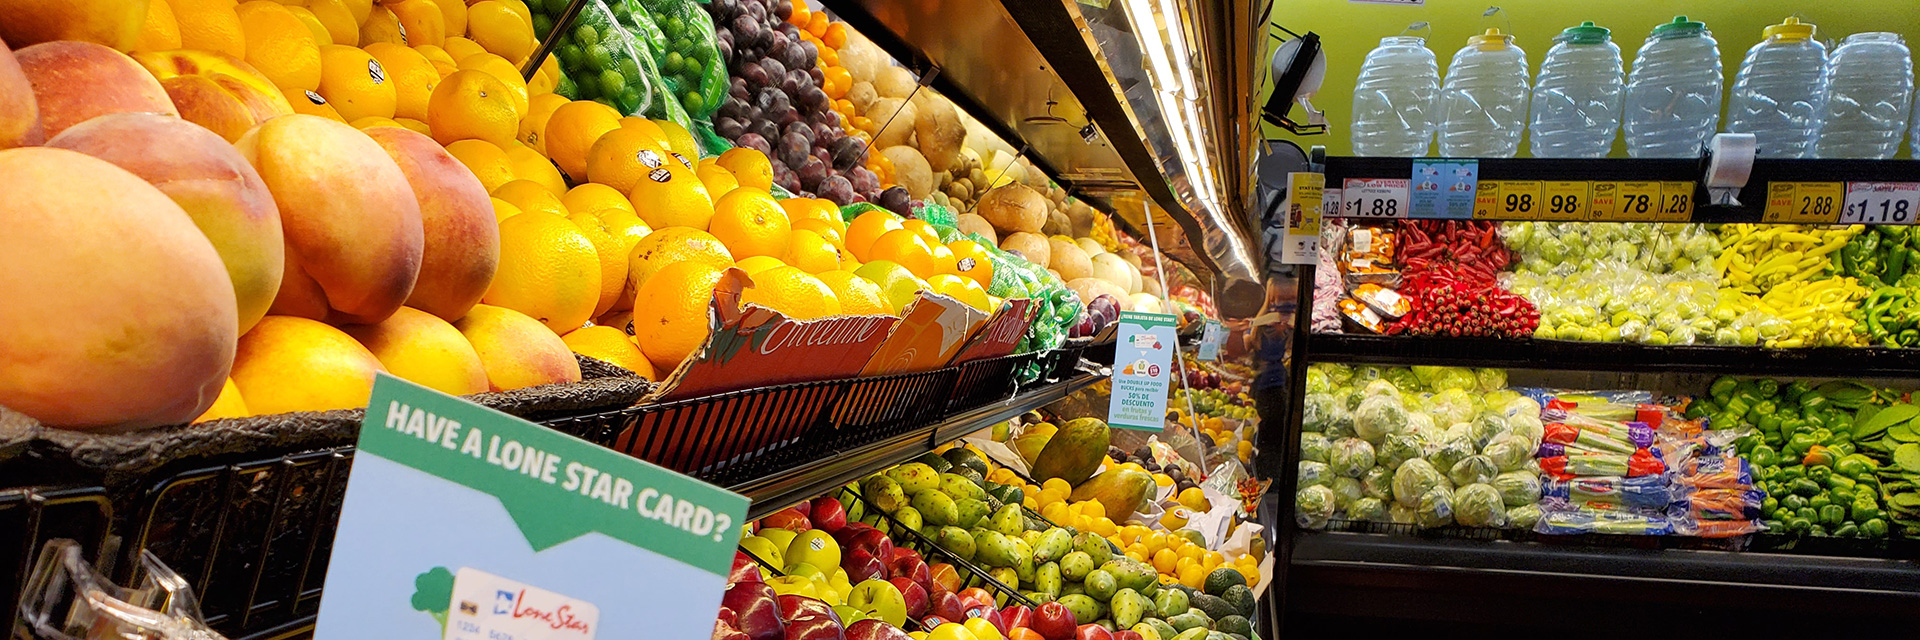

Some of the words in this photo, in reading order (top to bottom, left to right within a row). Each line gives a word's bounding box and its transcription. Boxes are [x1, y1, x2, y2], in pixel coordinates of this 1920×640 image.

[1345, 198, 1397, 217] $1.88
[1660, 194, 1688, 213] 1.28
[1847, 199, 1909, 222] $1.18
[1121, 399, 1154, 408] DESCUENTO
[1140, 414, 1159, 422] frescas
[385, 400, 462, 450] HAVE
[460, 417, 482, 459] A
[486, 434, 562, 485] LONE
[562, 462, 633, 510] STAR
[636, 487, 732, 543] CARD?
[513, 588, 553, 620] Lone
[550, 604, 589, 634] Star
